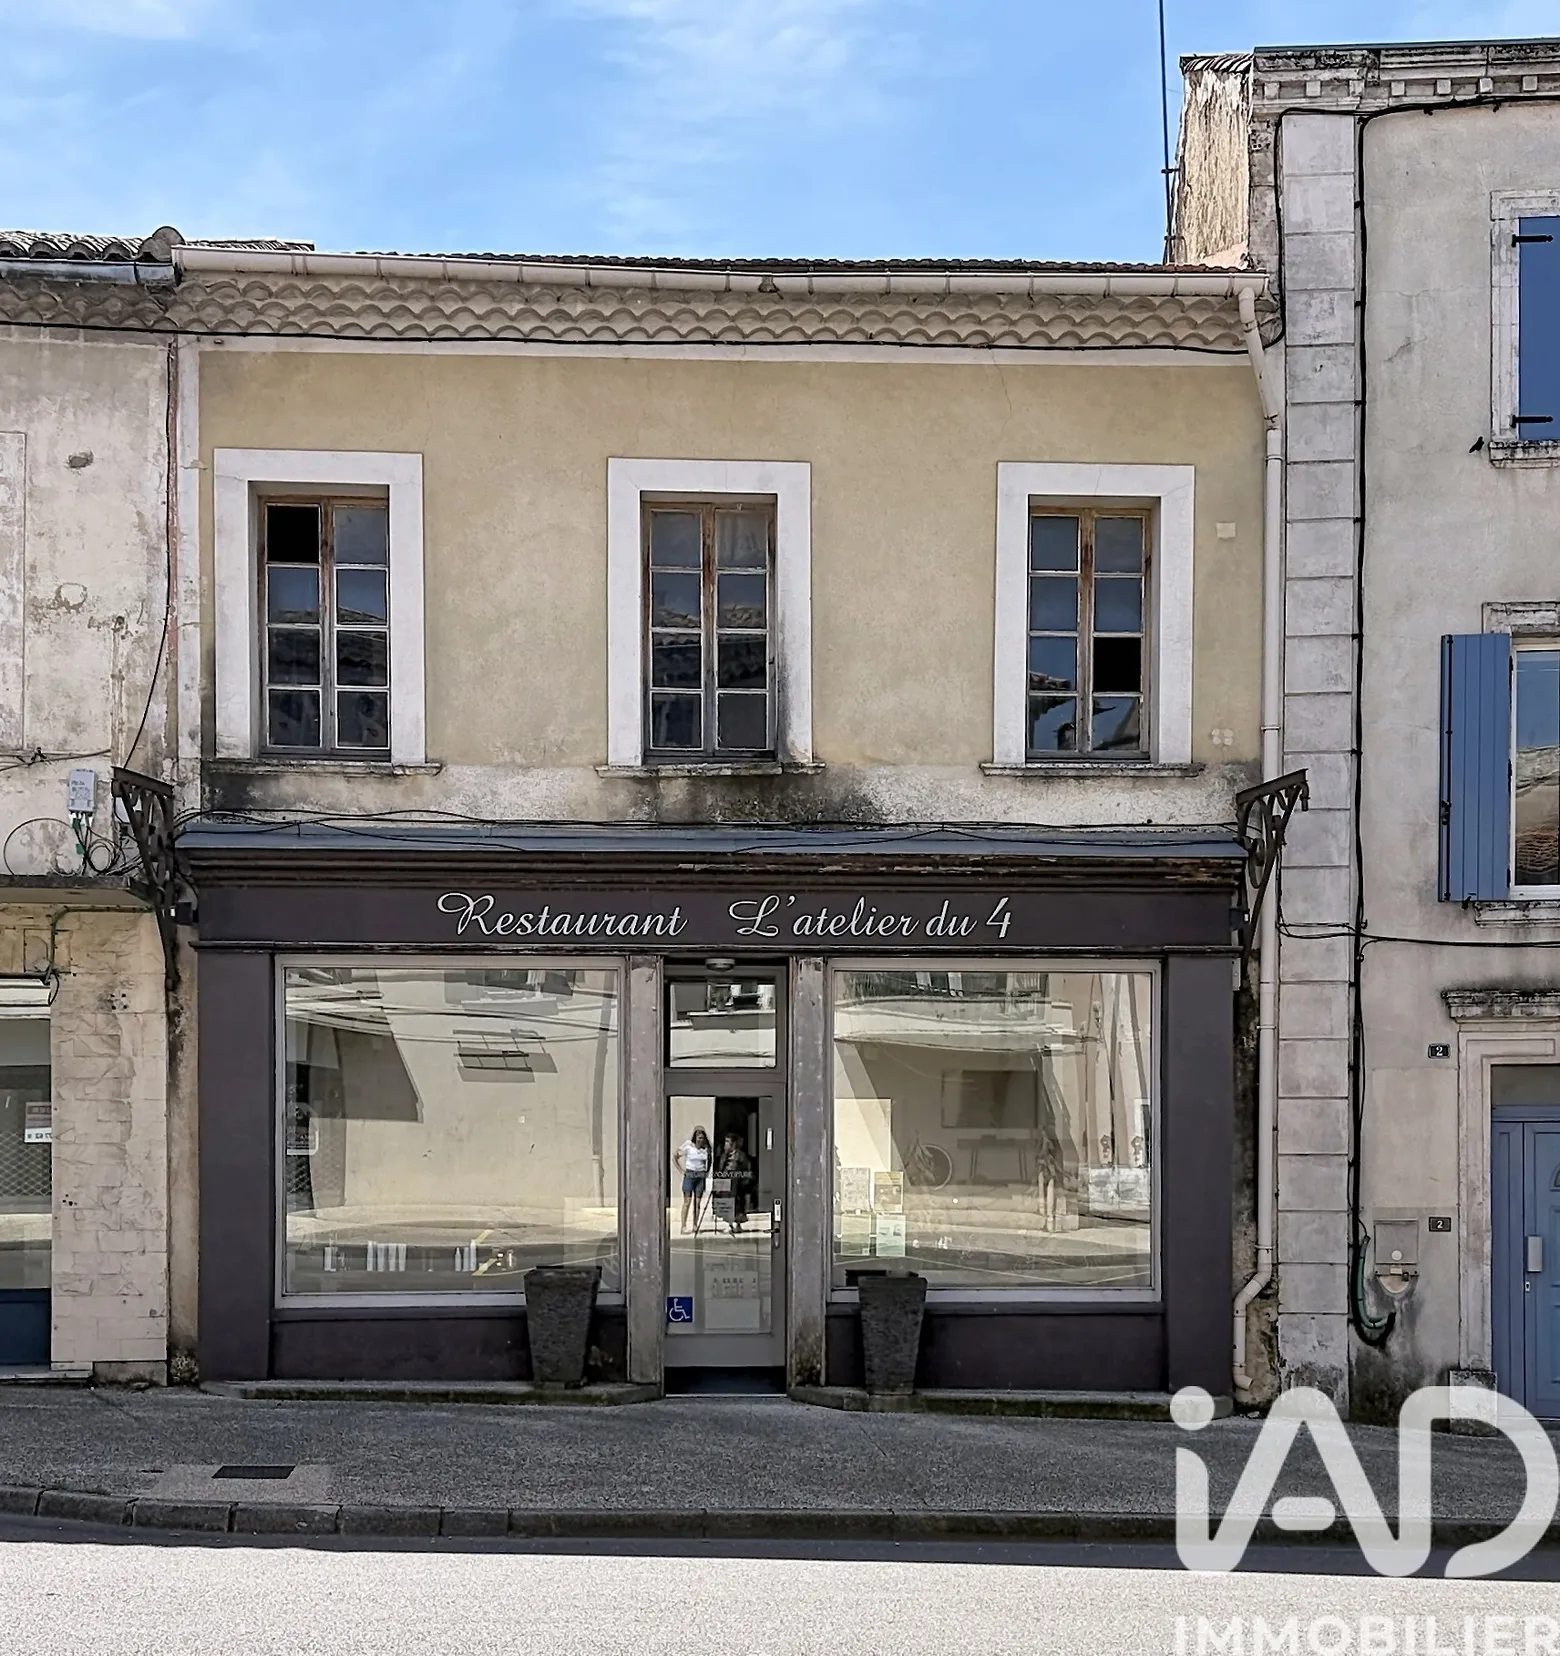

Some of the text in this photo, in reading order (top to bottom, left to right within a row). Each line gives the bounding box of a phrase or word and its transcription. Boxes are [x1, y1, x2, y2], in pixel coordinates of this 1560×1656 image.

[437, 892, 688, 937] Restaurant
[728, 895, 1012, 939] L'atelier du 4
[1435, 1046, 1443, 1056] 2
[1437, 1220, 1443, 1229] 2
